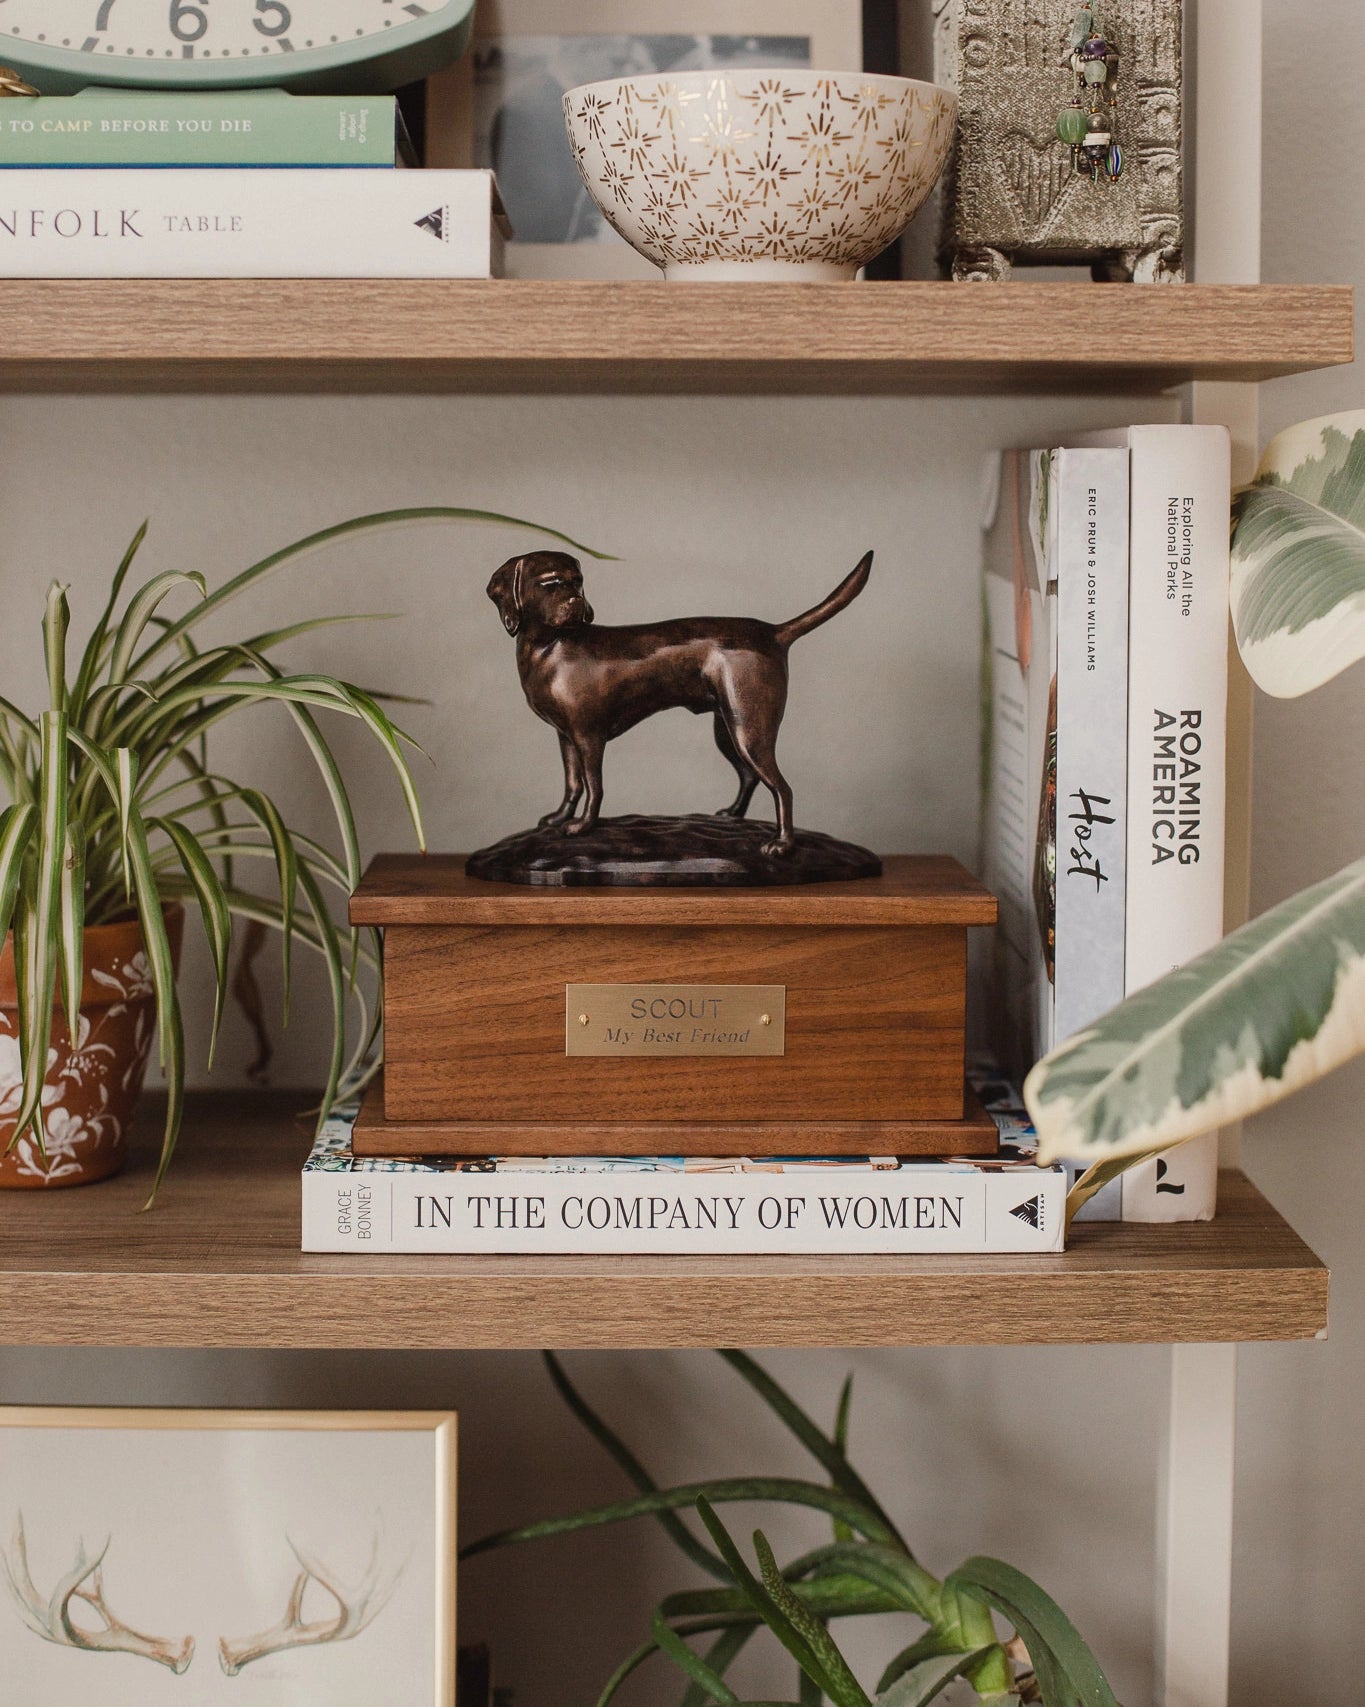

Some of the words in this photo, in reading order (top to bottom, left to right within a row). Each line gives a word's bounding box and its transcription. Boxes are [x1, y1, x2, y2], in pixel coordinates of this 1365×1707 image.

[169, 0, 208, 42] 6
[9, 119, 34, 132] TO
[41, 119, 93, 132] CAMP
[101, 119, 169, 132] BEFORE
[176, 119, 212, 132] YOU
[220, 119, 252, 132] DIE
[163, 215, 243, 232] TABLE
[1088, 488, 1097, 516] ERIC
[1088, 521, 1096, 555] PRUM
[1167, 497, 1179, 556] National
[1179, 497, 1194, 567] Exploring
[1088, 560, 1096, 568] &
[1166, 561, 1178, 600] Parks
[1181, 570, 1193, 589] All
[1088, 573, 1096, 605] JOSH
[1181, 593, 1192, 617] the
[1087, 610, 1096, 671] WILLIAMS
[1151, 708, 1177, 866] AMERICA
[1178, 709, 1202, 866] ROAMING
[1065, 787, 1117, 894] Host
[631, 998, 723, 1019] SCOUT
[603, 1028, 635, 1045] My
[643, 1028, 681, 1043] Best
[690, 1028, 750, 1043] Friend
[337, 1189, 352, 1235] GRACE
[357, 1183, 372, 1239] BONNEY
[414, 1195, 454, 1229] IN
[467, 1195, 547, 1229] THE
[561, 1196, 747, 1230] COMPANY
[757, 1196, 805, 1230] OF
[818, 1196, 965, 1230] WOMEN
